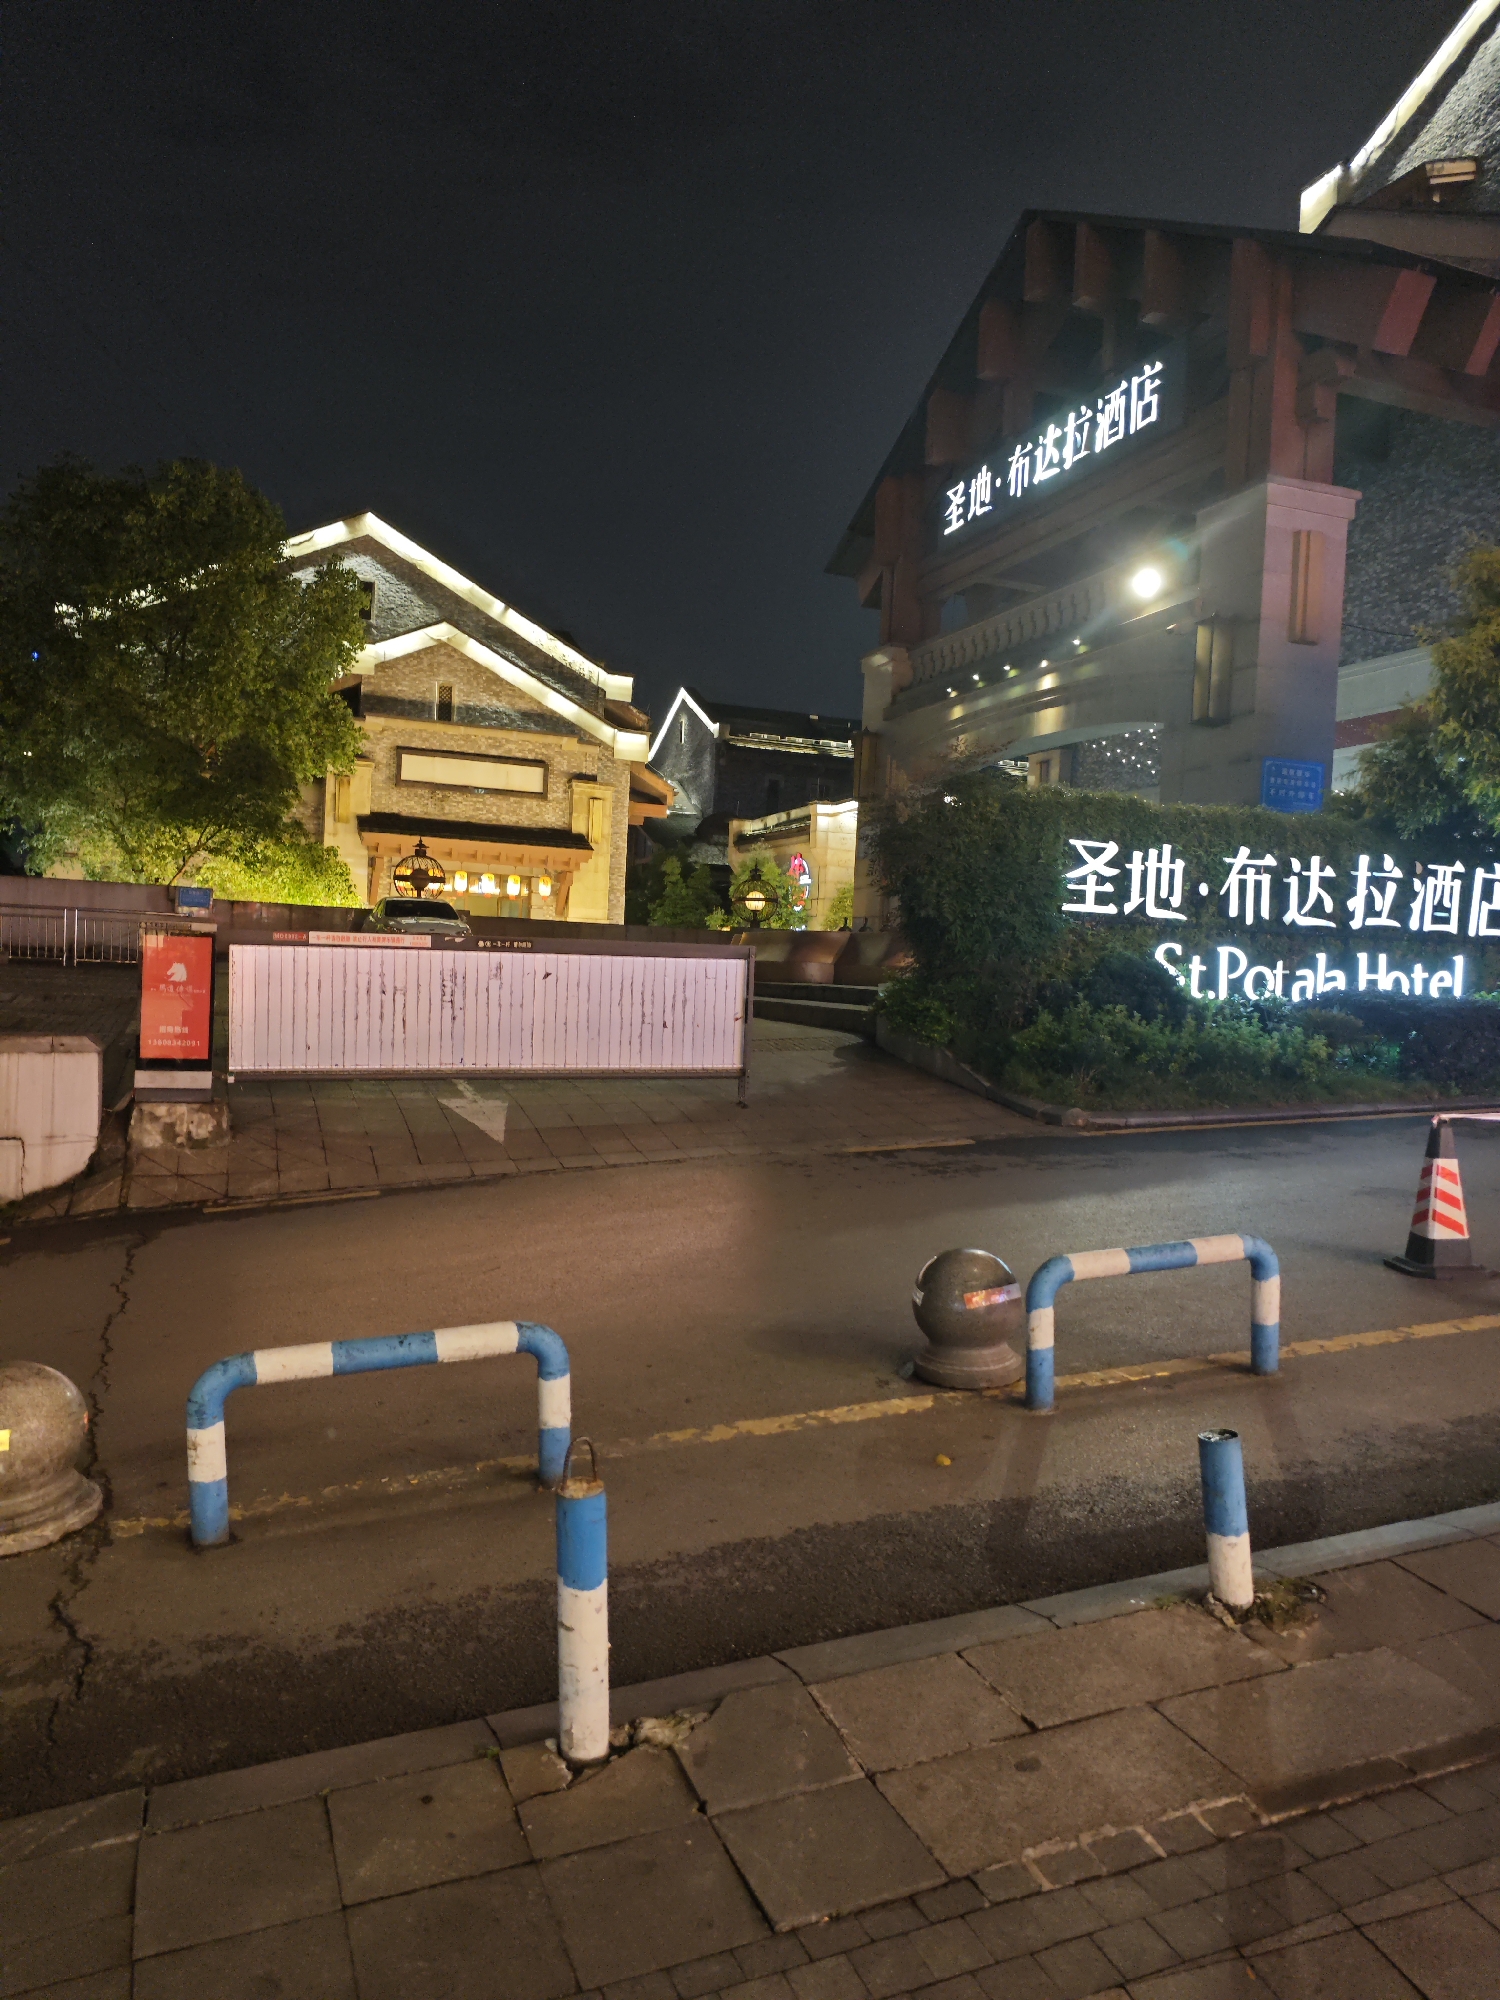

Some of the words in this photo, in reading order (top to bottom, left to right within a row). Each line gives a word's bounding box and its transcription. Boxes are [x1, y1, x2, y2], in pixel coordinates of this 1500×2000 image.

[943, 361, 1163, 535] 圣地·布达拉酒店
[1061, 838, 1500, 937] 圣地·布达拉酒店
[1357, 952, 1464, 999] Hotel
